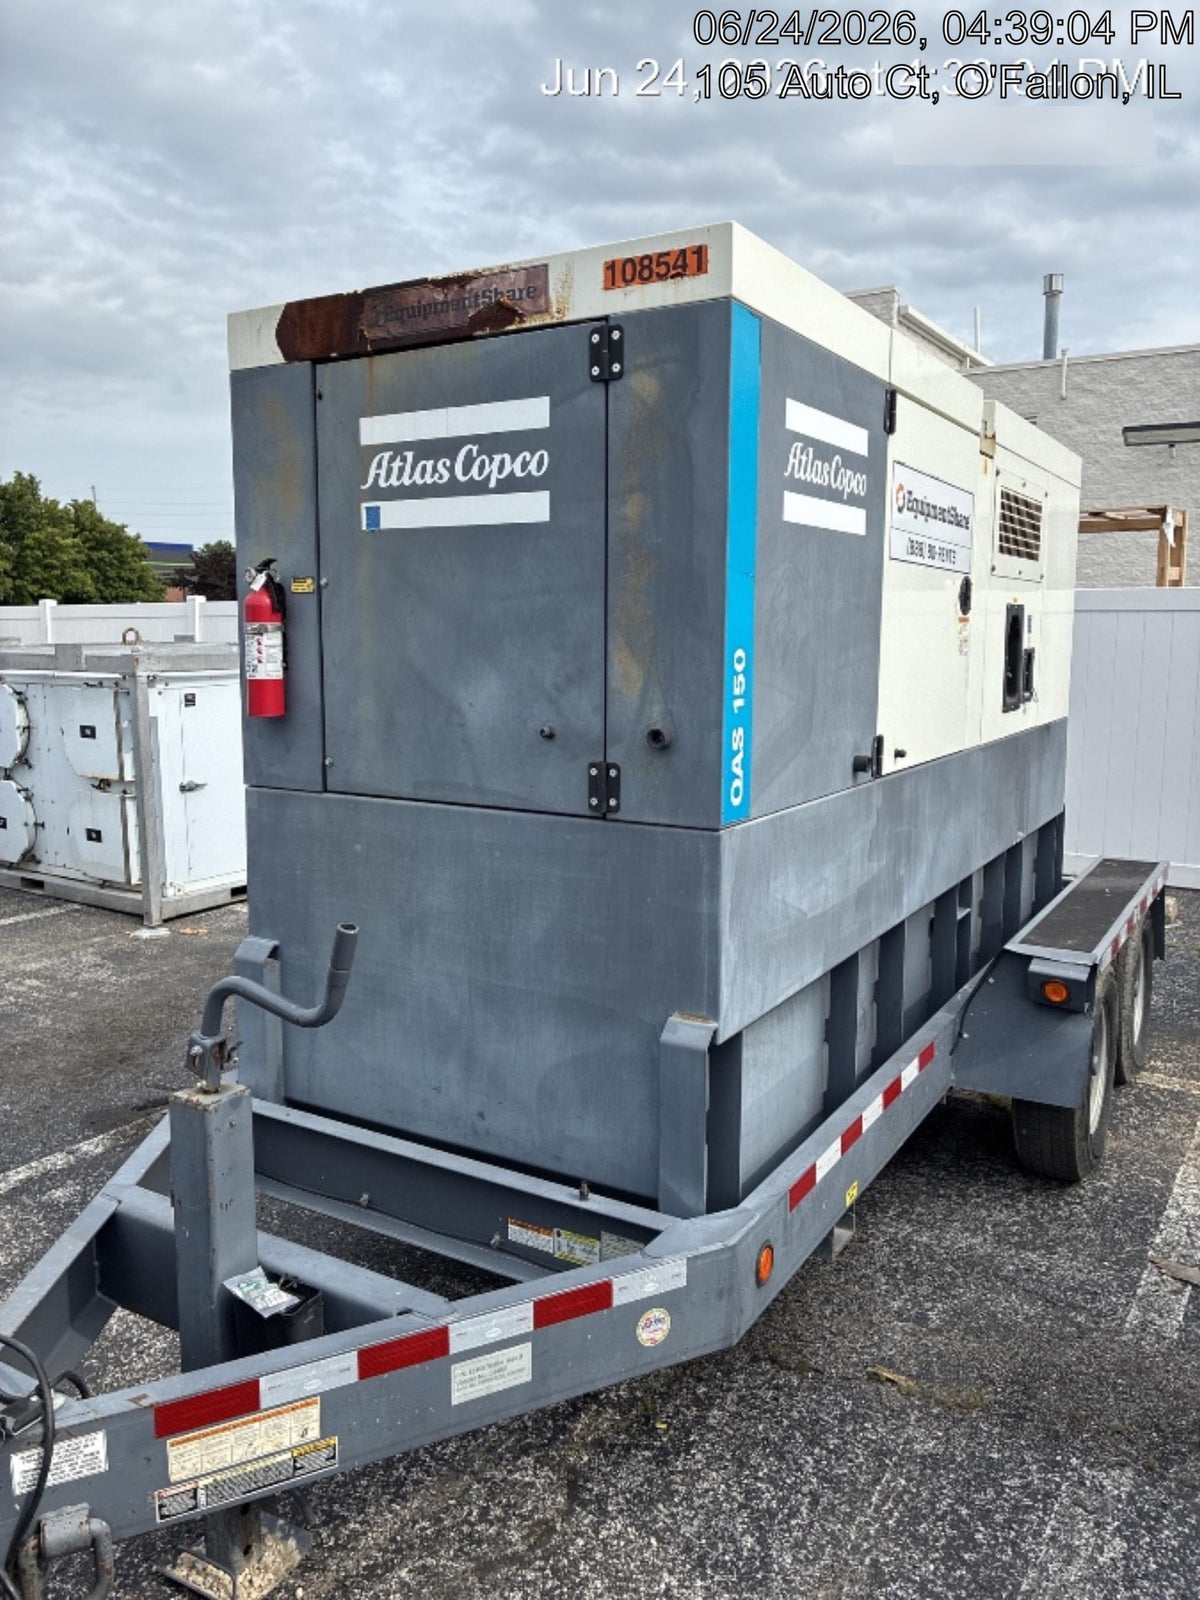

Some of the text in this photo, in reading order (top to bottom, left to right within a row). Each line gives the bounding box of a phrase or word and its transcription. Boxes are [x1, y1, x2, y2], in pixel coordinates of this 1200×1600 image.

[605, 244, 704, 287] 108541
[360, 444, 549, 490] Atlas Copco
[783, 441, 867, 501] Atlas Copco
[906, 489, 970, 531] EquipmentShare
[732, 648, 746, 714] 150
